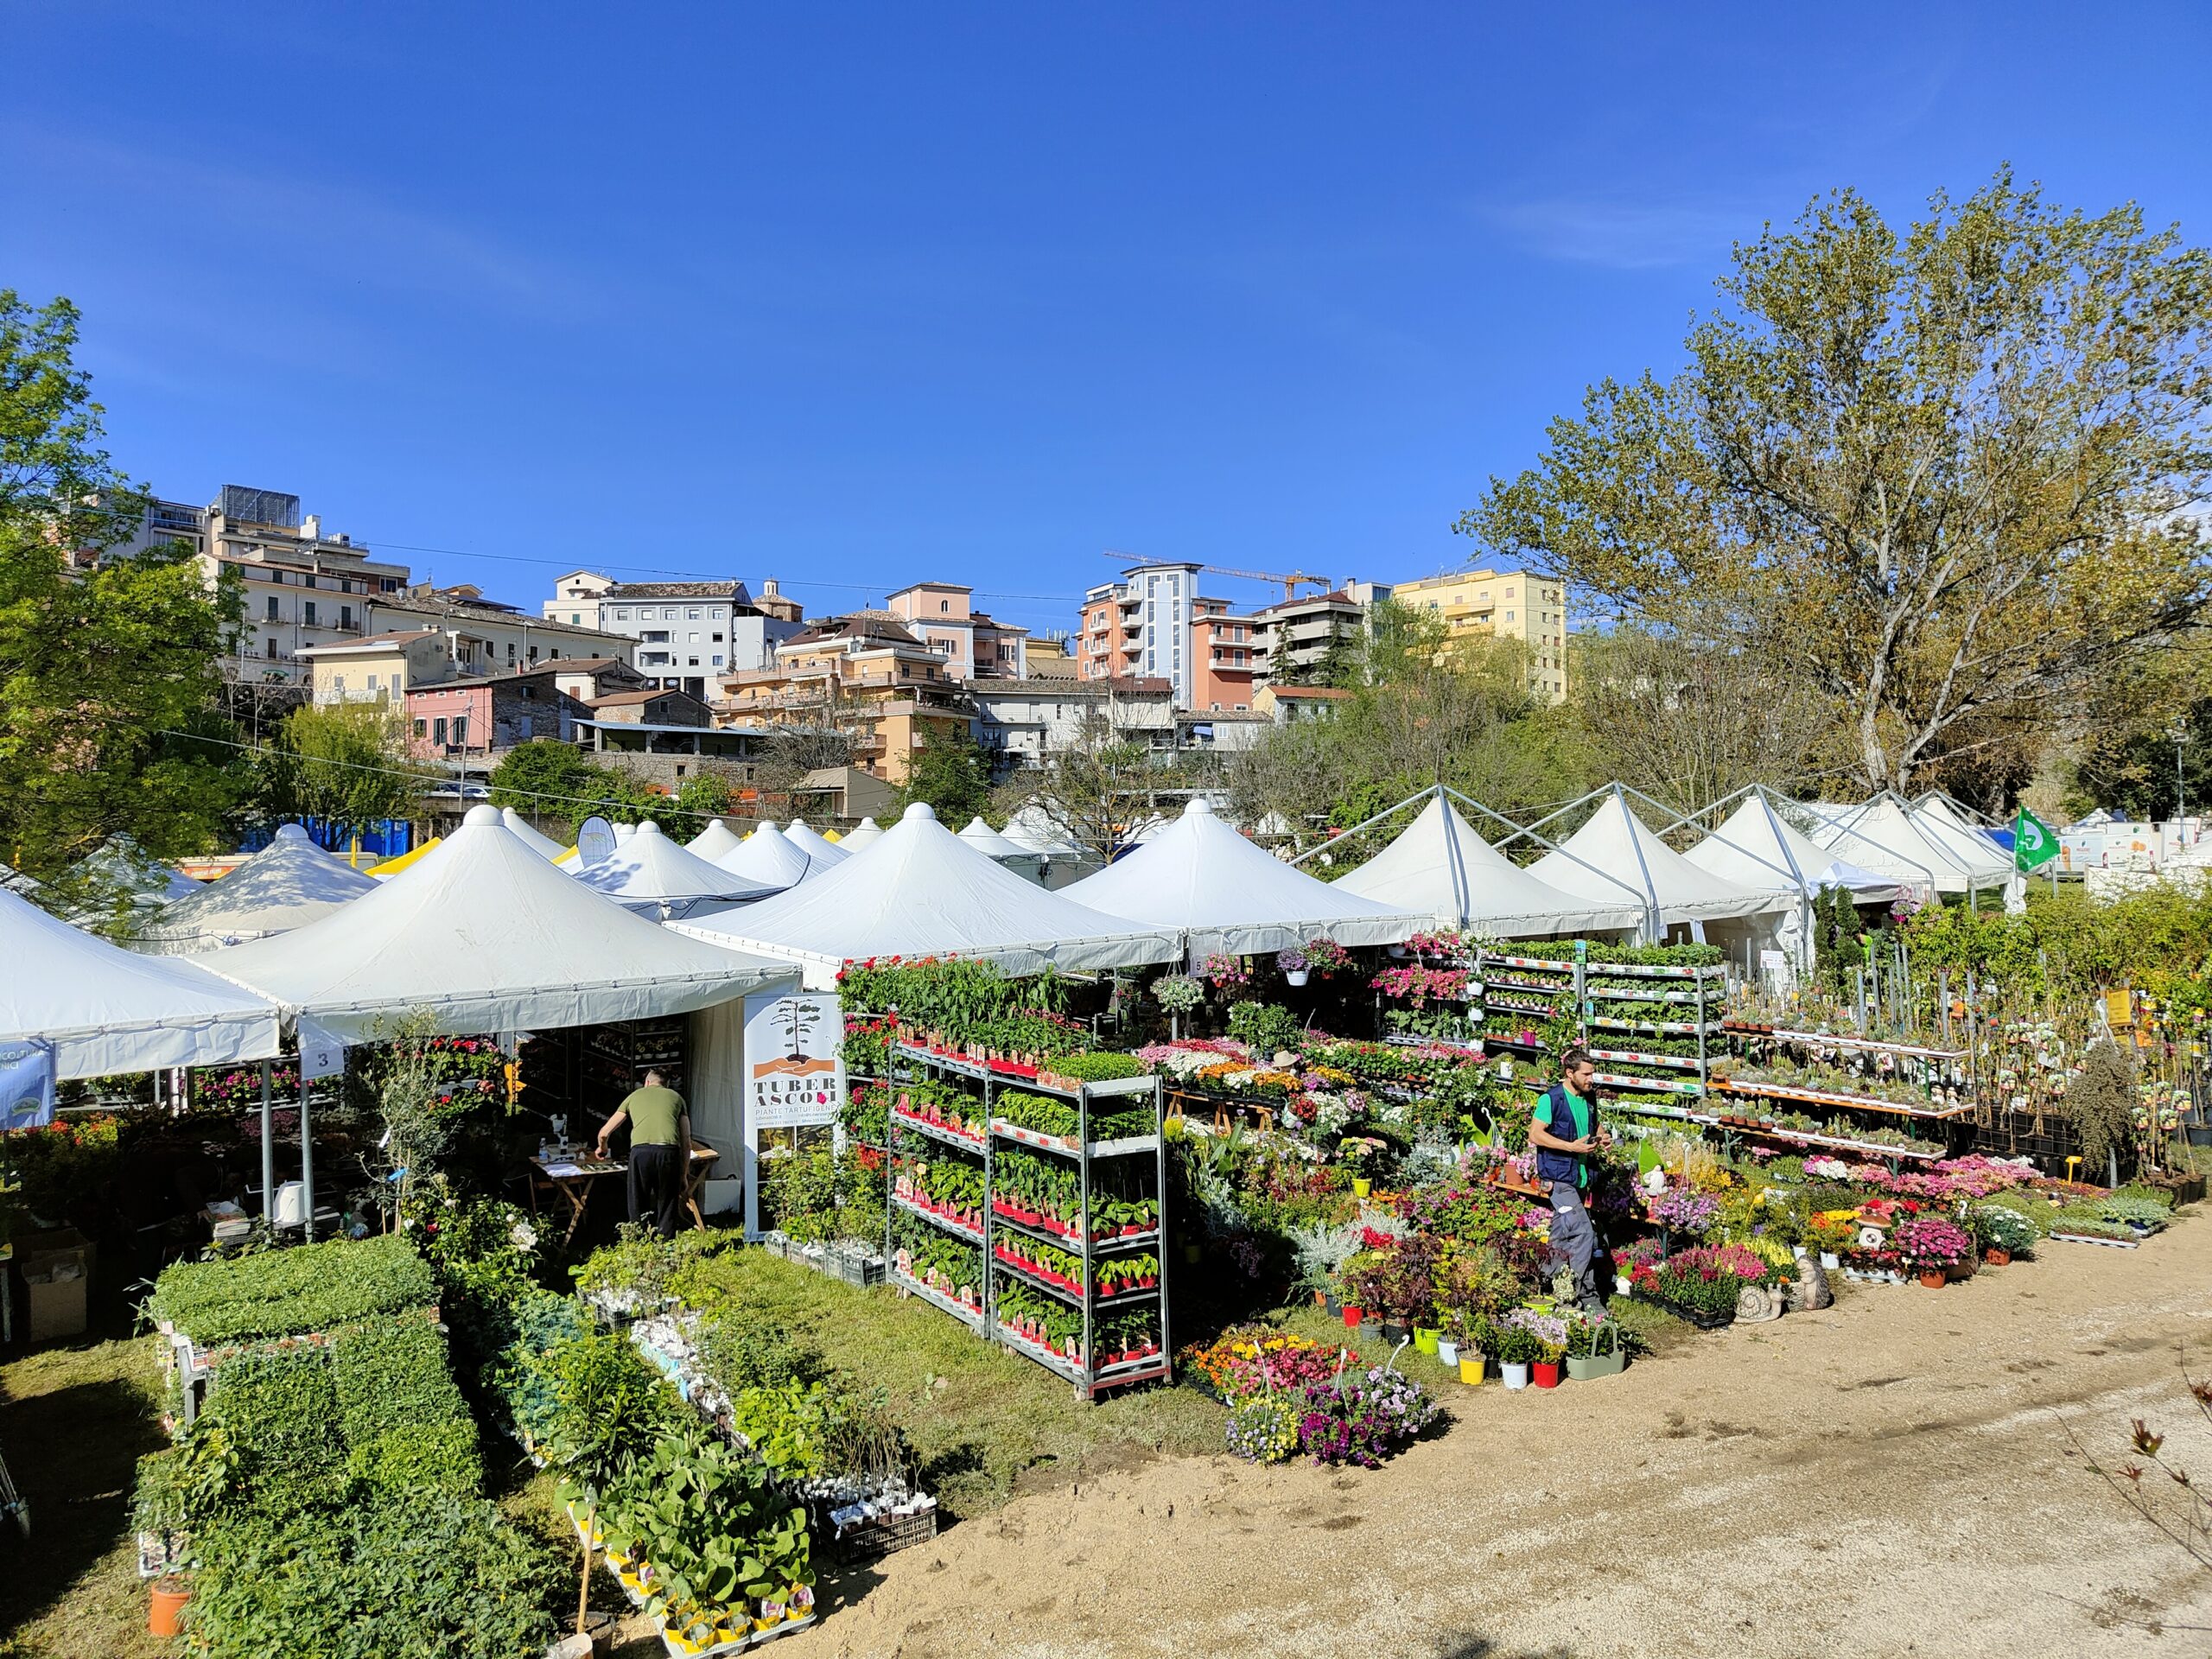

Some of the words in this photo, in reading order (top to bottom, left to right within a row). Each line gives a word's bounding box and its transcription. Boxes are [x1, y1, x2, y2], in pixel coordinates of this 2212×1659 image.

[1196, 961, 1202, 971] 5
[317, 1052, 328, 1067] 3
[753, 1078, 836, 1094] TUBER
[785, 1105, 836, 1114] TARTUFIGENE
